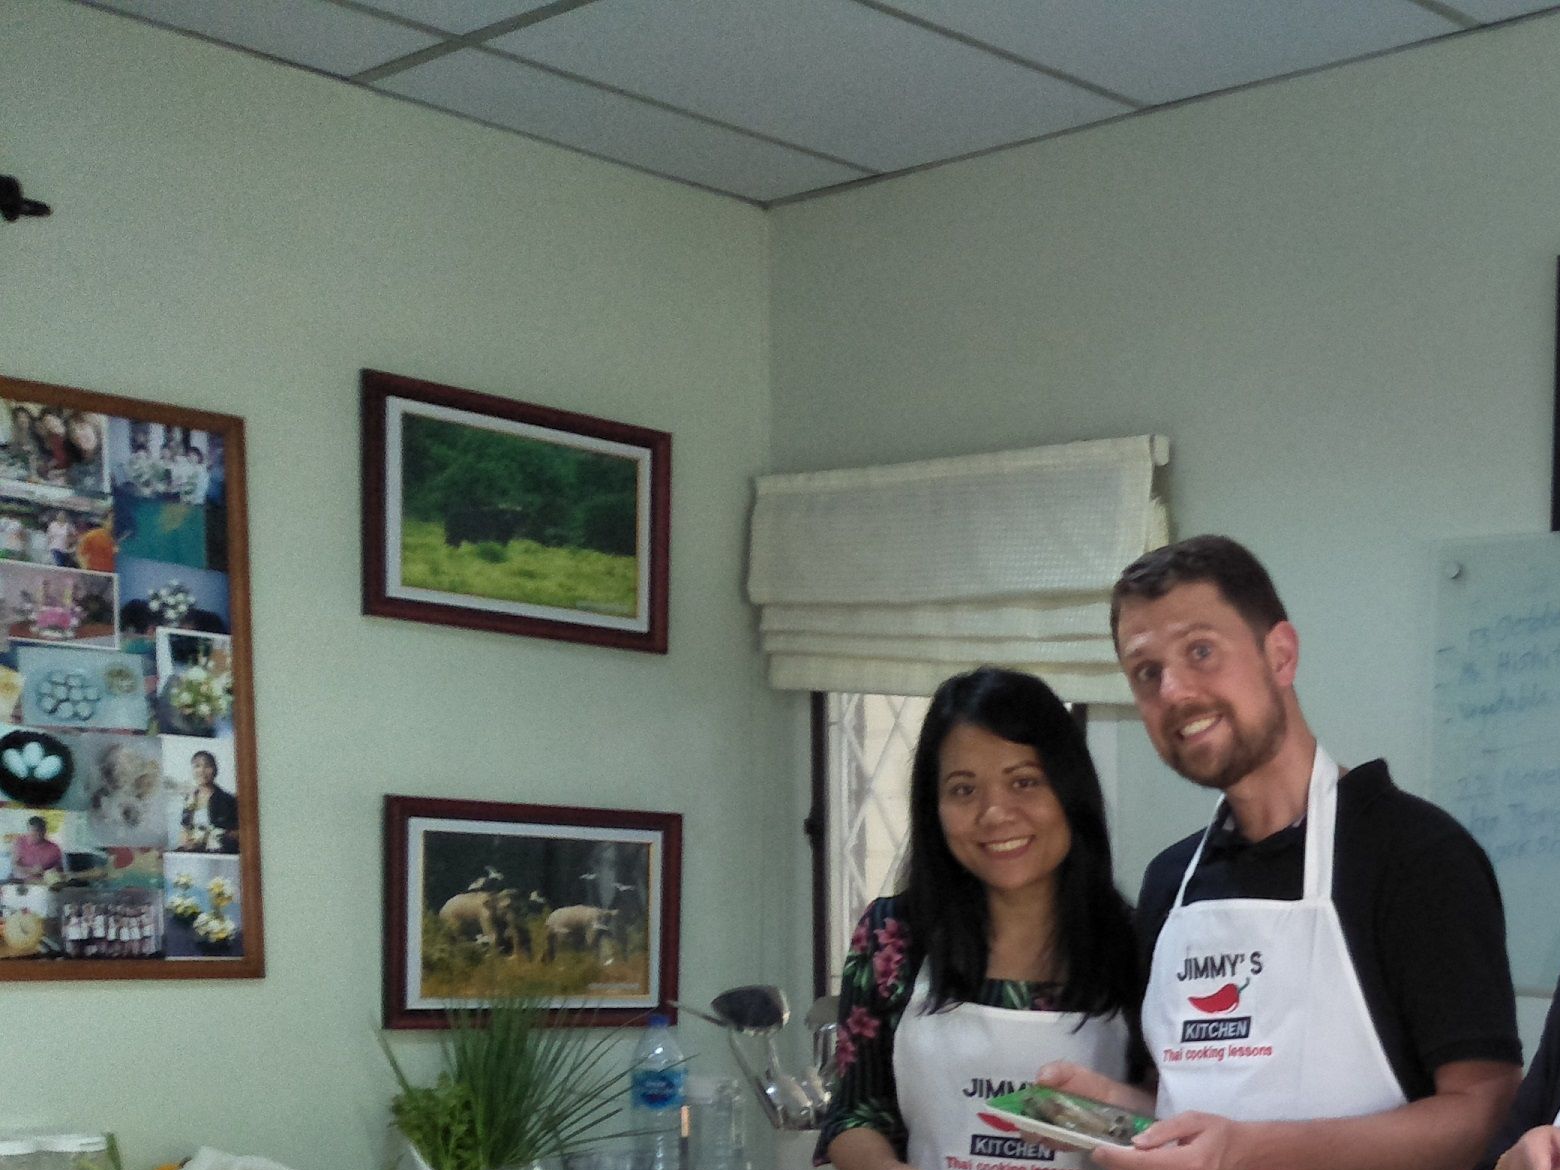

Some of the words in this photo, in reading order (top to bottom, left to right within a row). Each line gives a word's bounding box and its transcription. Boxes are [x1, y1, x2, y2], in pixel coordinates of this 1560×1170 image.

[1177, 951, 1263, 982] JIMMY'S
[1185, 1020, 1248, 1039] KITCHEN
[1163, 1048, 1183, 1062] Thai
[1185, 1046, 1225, 1061] cooking
[1228, 1045, 1273, 1057] lessons
[962, 1077, 1035, 1100] JIMM
[974, 1137, 1051, 1160] KITCHEN
[946, 1156, 972, 1170] Thai
